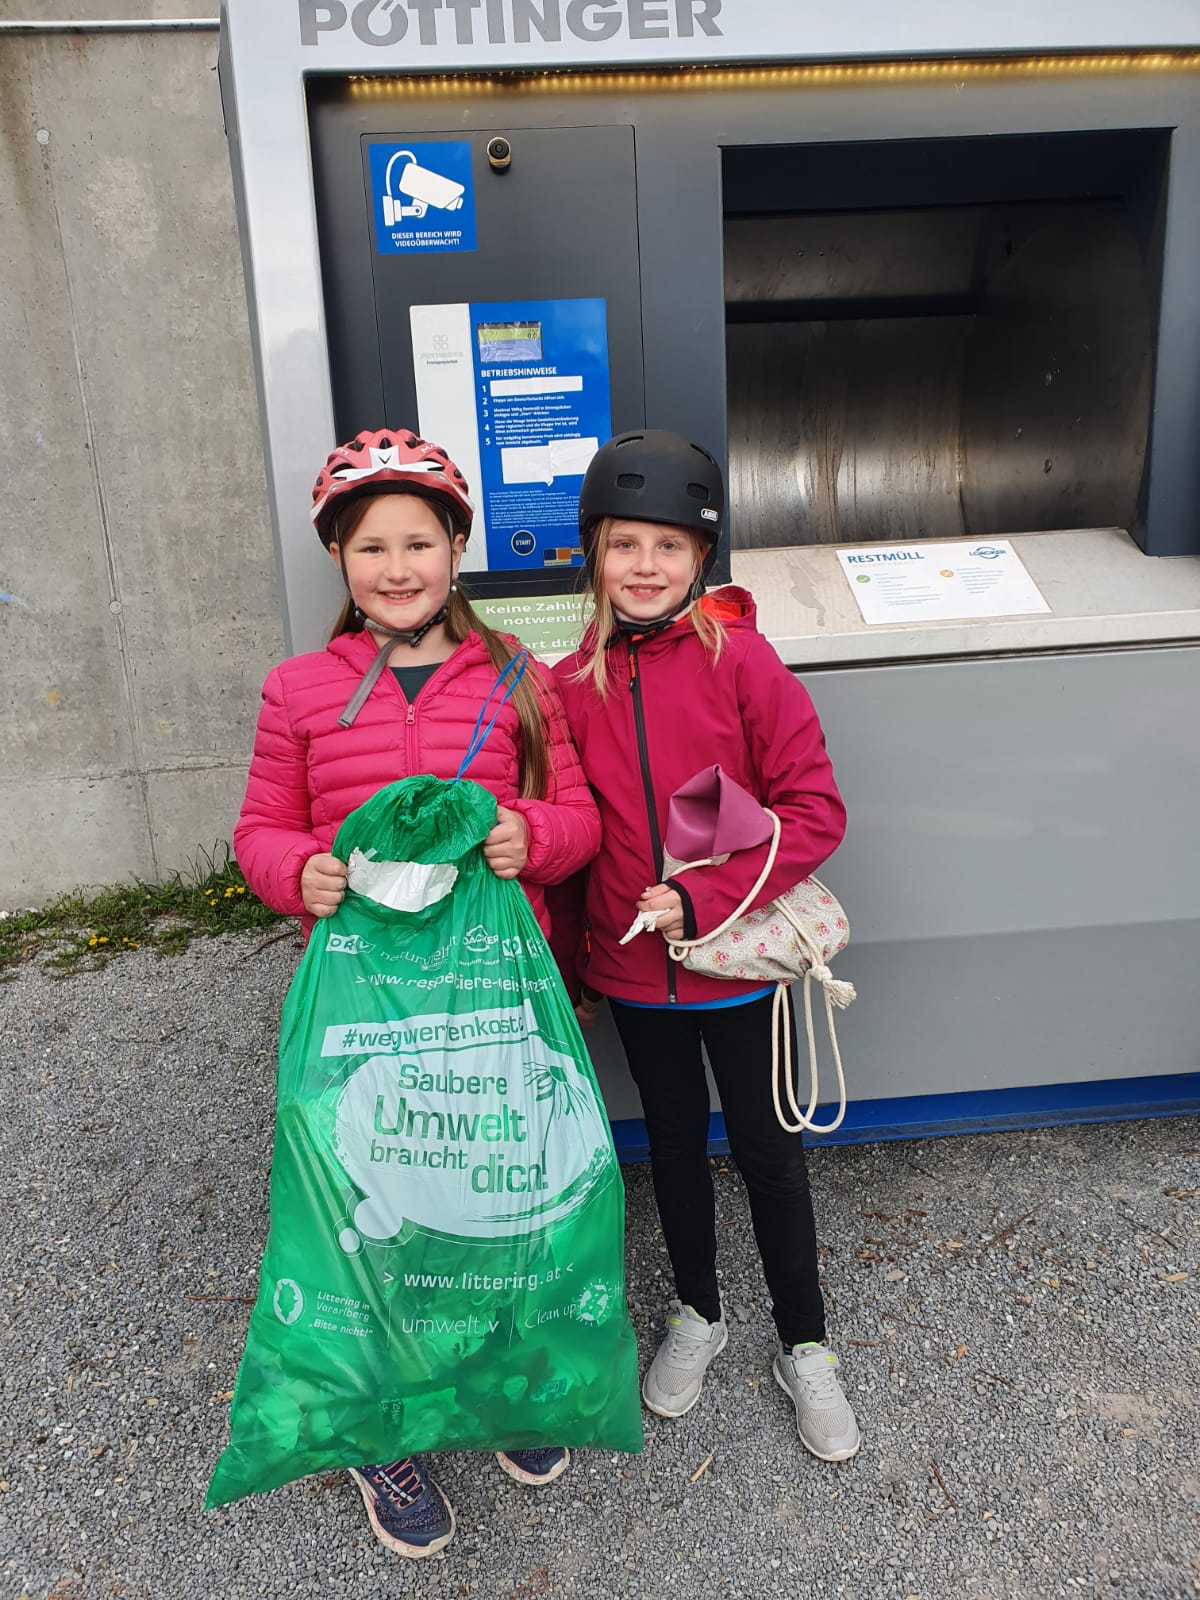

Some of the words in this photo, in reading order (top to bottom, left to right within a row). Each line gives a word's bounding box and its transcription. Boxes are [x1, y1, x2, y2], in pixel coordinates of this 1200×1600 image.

[299, 0, 724, 46] PÖTTINGER
[391, 232, 414, 240] DIESER
[415, 231, 443, 239] BEREICH
[443, 230, 462, 238] WIRD
[394, 238, 461, 248] VIDEOÜBERWACHT!
[481, 366, 557, 378] BETRIEBSHINWEISE
[482, 385, 487, 393] 1
[482, 397, 489, 405] 2
[485, 437, 491, 445] 5
[847, 551, 925, 564] RESTMÜLL
[486, 604, 531, 615] Keine
[522, 640, 546, 649] art
[398, 1063, 508, 1096] Saubere
[374, 1094, 527, 1143] Umwelt
[369, 1139, 469, 1169] braucht
[317, 1290, 361, 1309] Littering
[362, 1300, 370, 1311] in
[316, 1301, 370, 1323] Vorarlberg
[524, 1306, 560, 1329] Clean
[563, 1303, 577, 1319] up
[401, 1313, 481, 1334] umwelt
